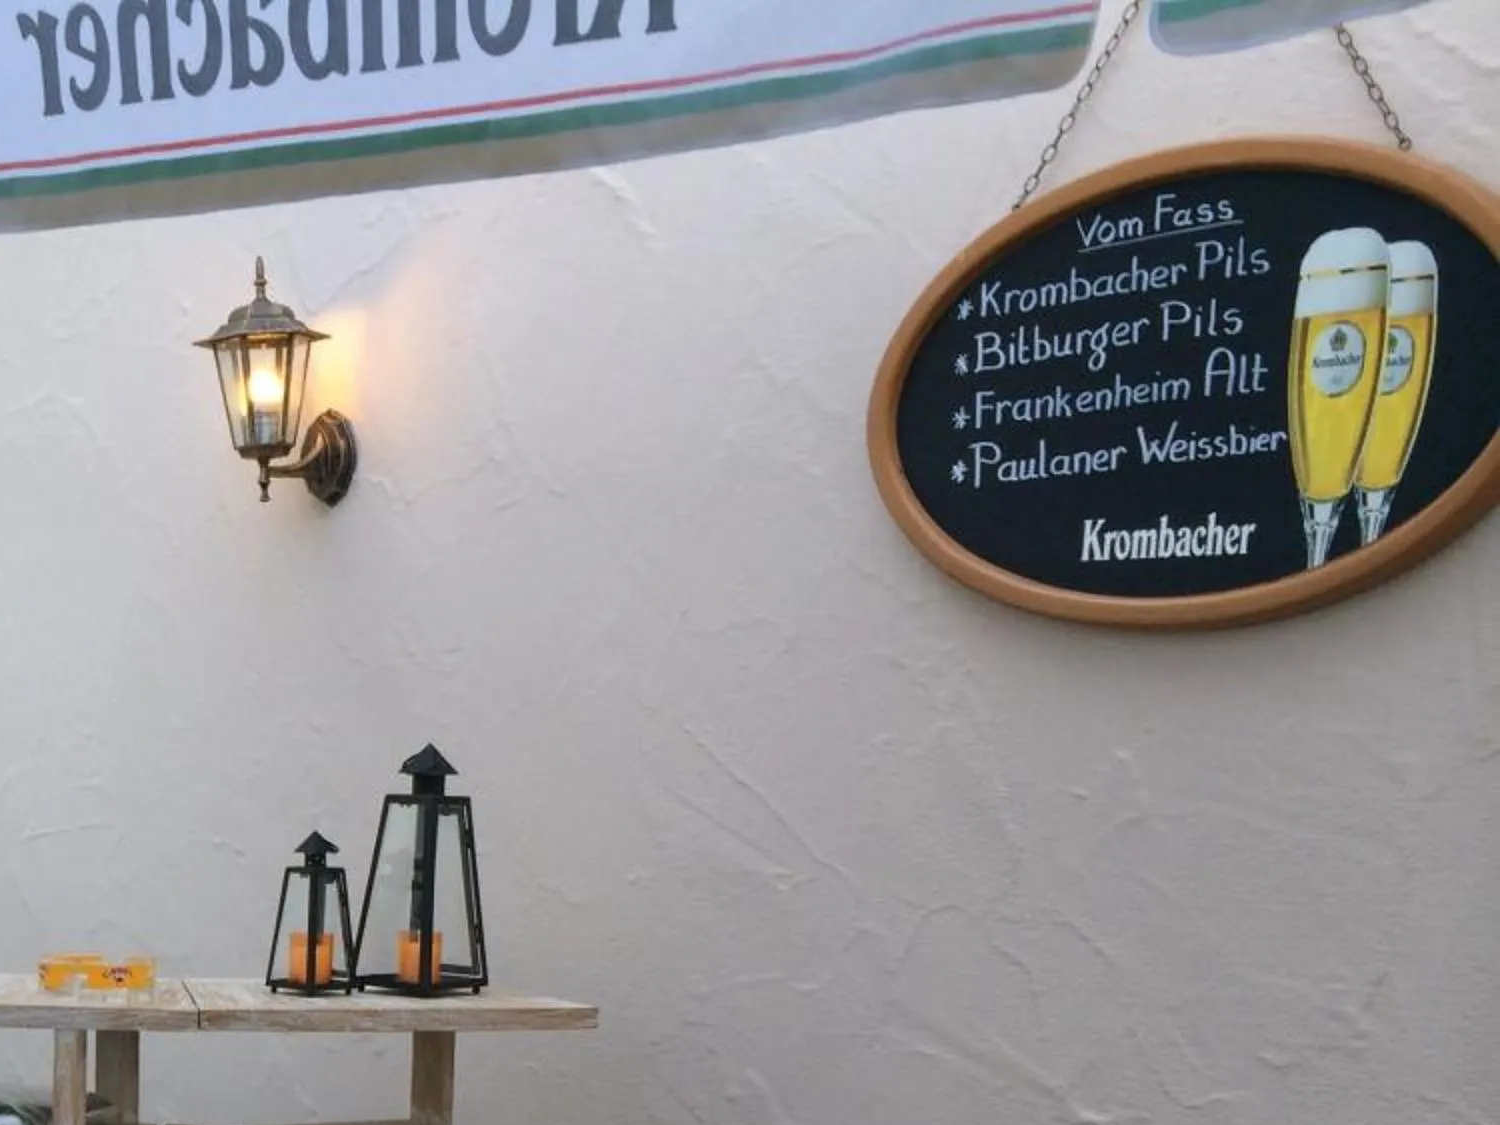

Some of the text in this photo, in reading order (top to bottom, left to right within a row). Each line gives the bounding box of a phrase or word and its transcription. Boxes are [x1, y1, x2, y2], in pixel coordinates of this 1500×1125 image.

[1076, 193, 1235, 247] Vom Fass
[980, 237, 1271, 318] Krombacher Pils
[974, 298, 1244, 373] Bitburger Pils
[974, 347, 1269, 429] Frankenheim Alt
[968, 421, 1287, 488] Paulaner Weissbier
[1080, 511, 1257, 562] Krombacher
